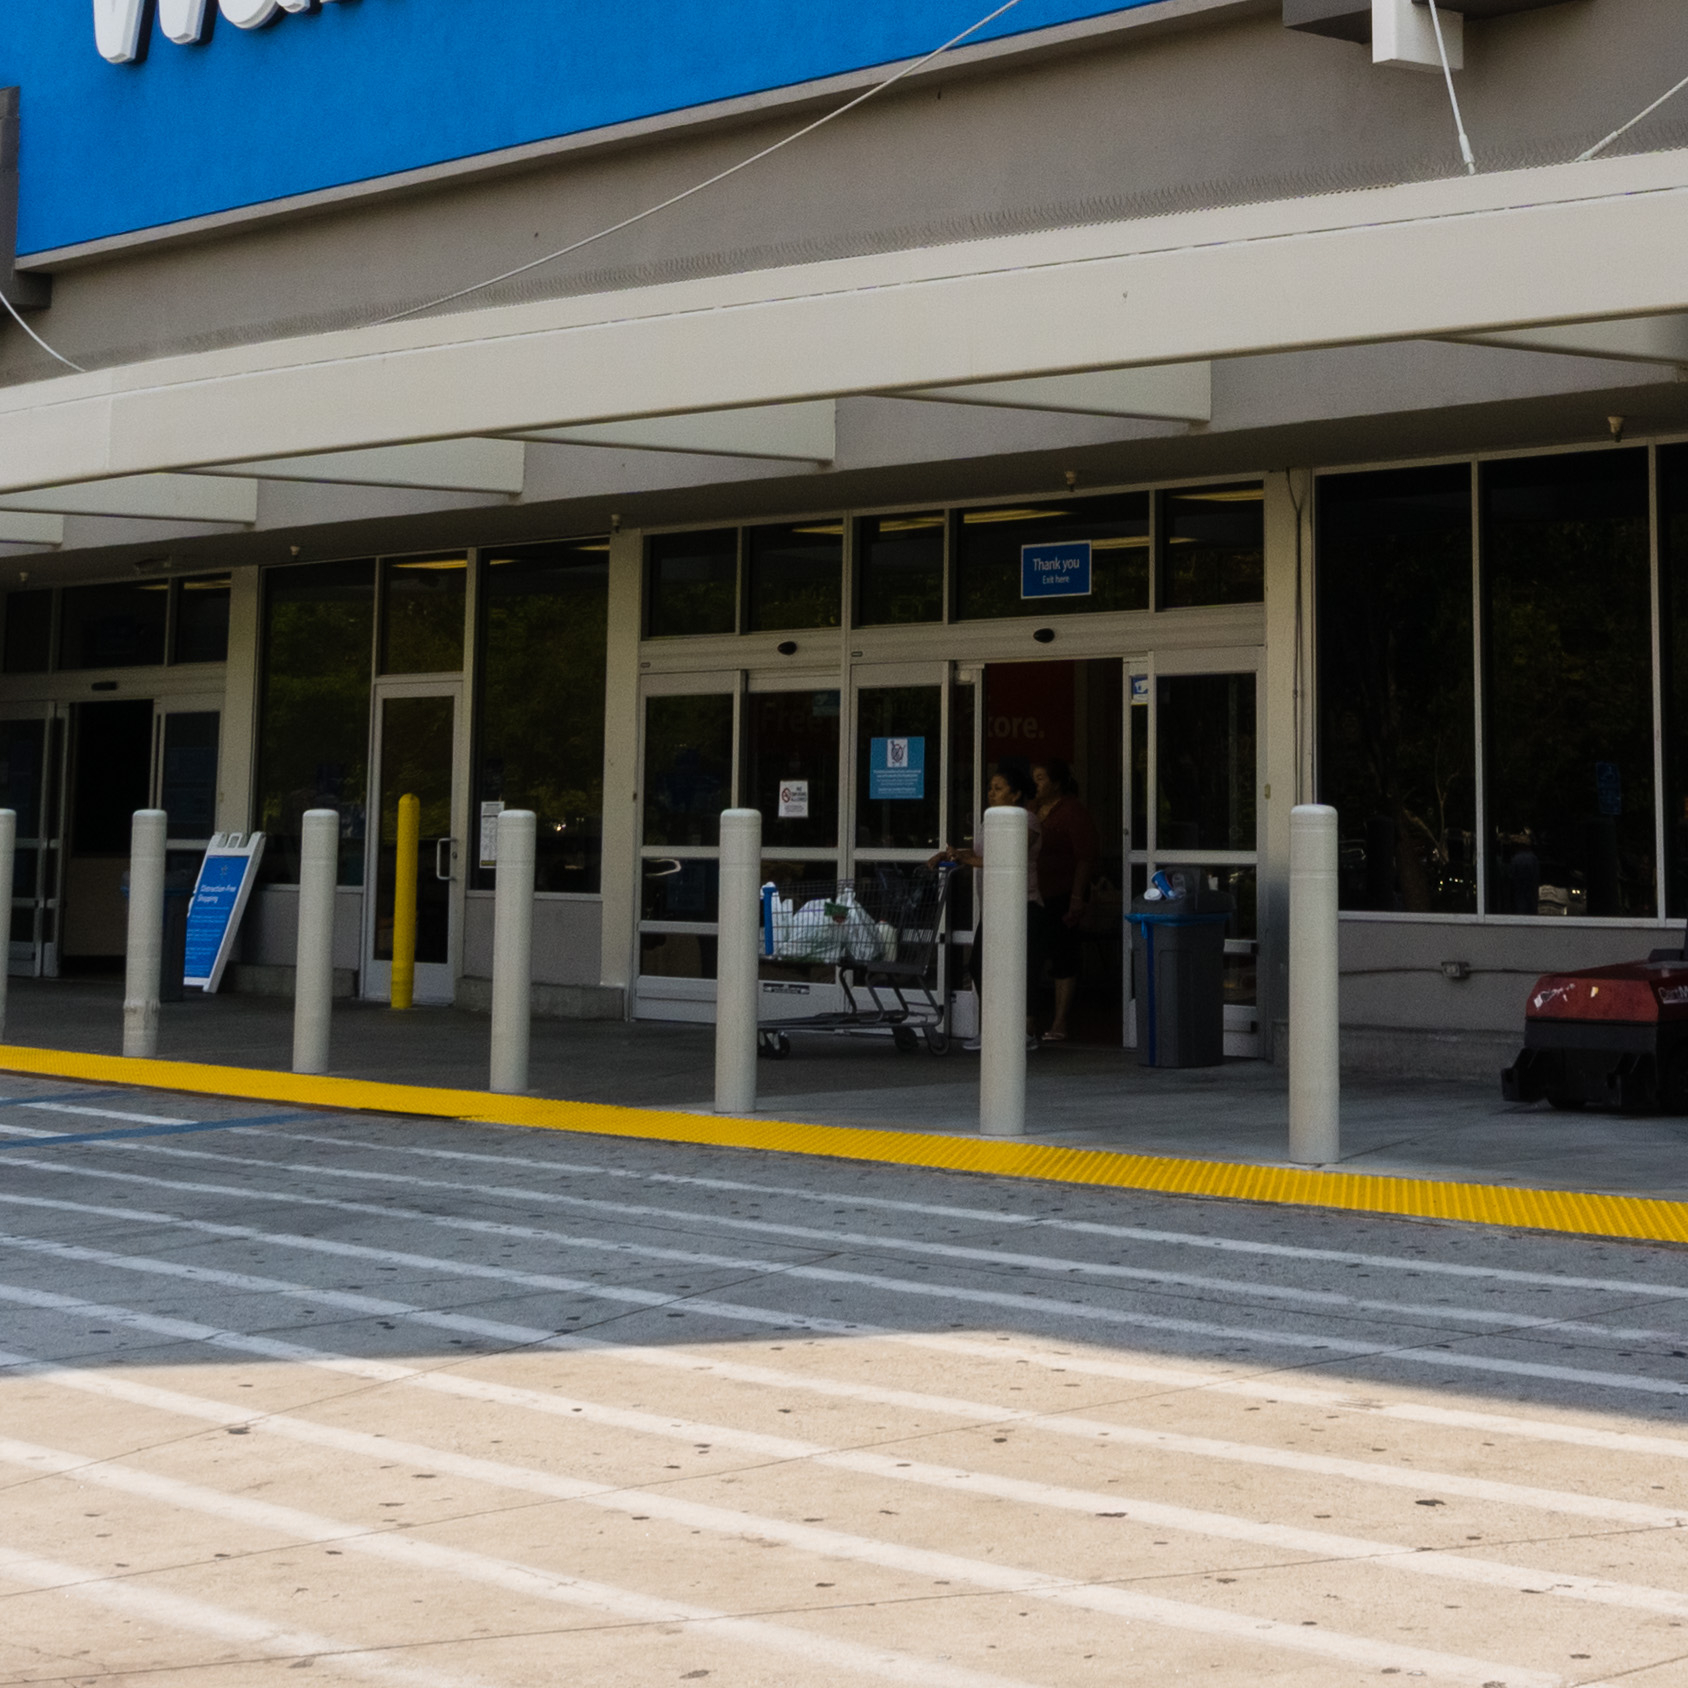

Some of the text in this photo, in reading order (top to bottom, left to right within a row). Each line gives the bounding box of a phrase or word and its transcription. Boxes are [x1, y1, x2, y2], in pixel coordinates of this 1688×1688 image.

[1033, 556, 1080, 573] Thank you
[1043, 574, 1070, 585] Exit here
